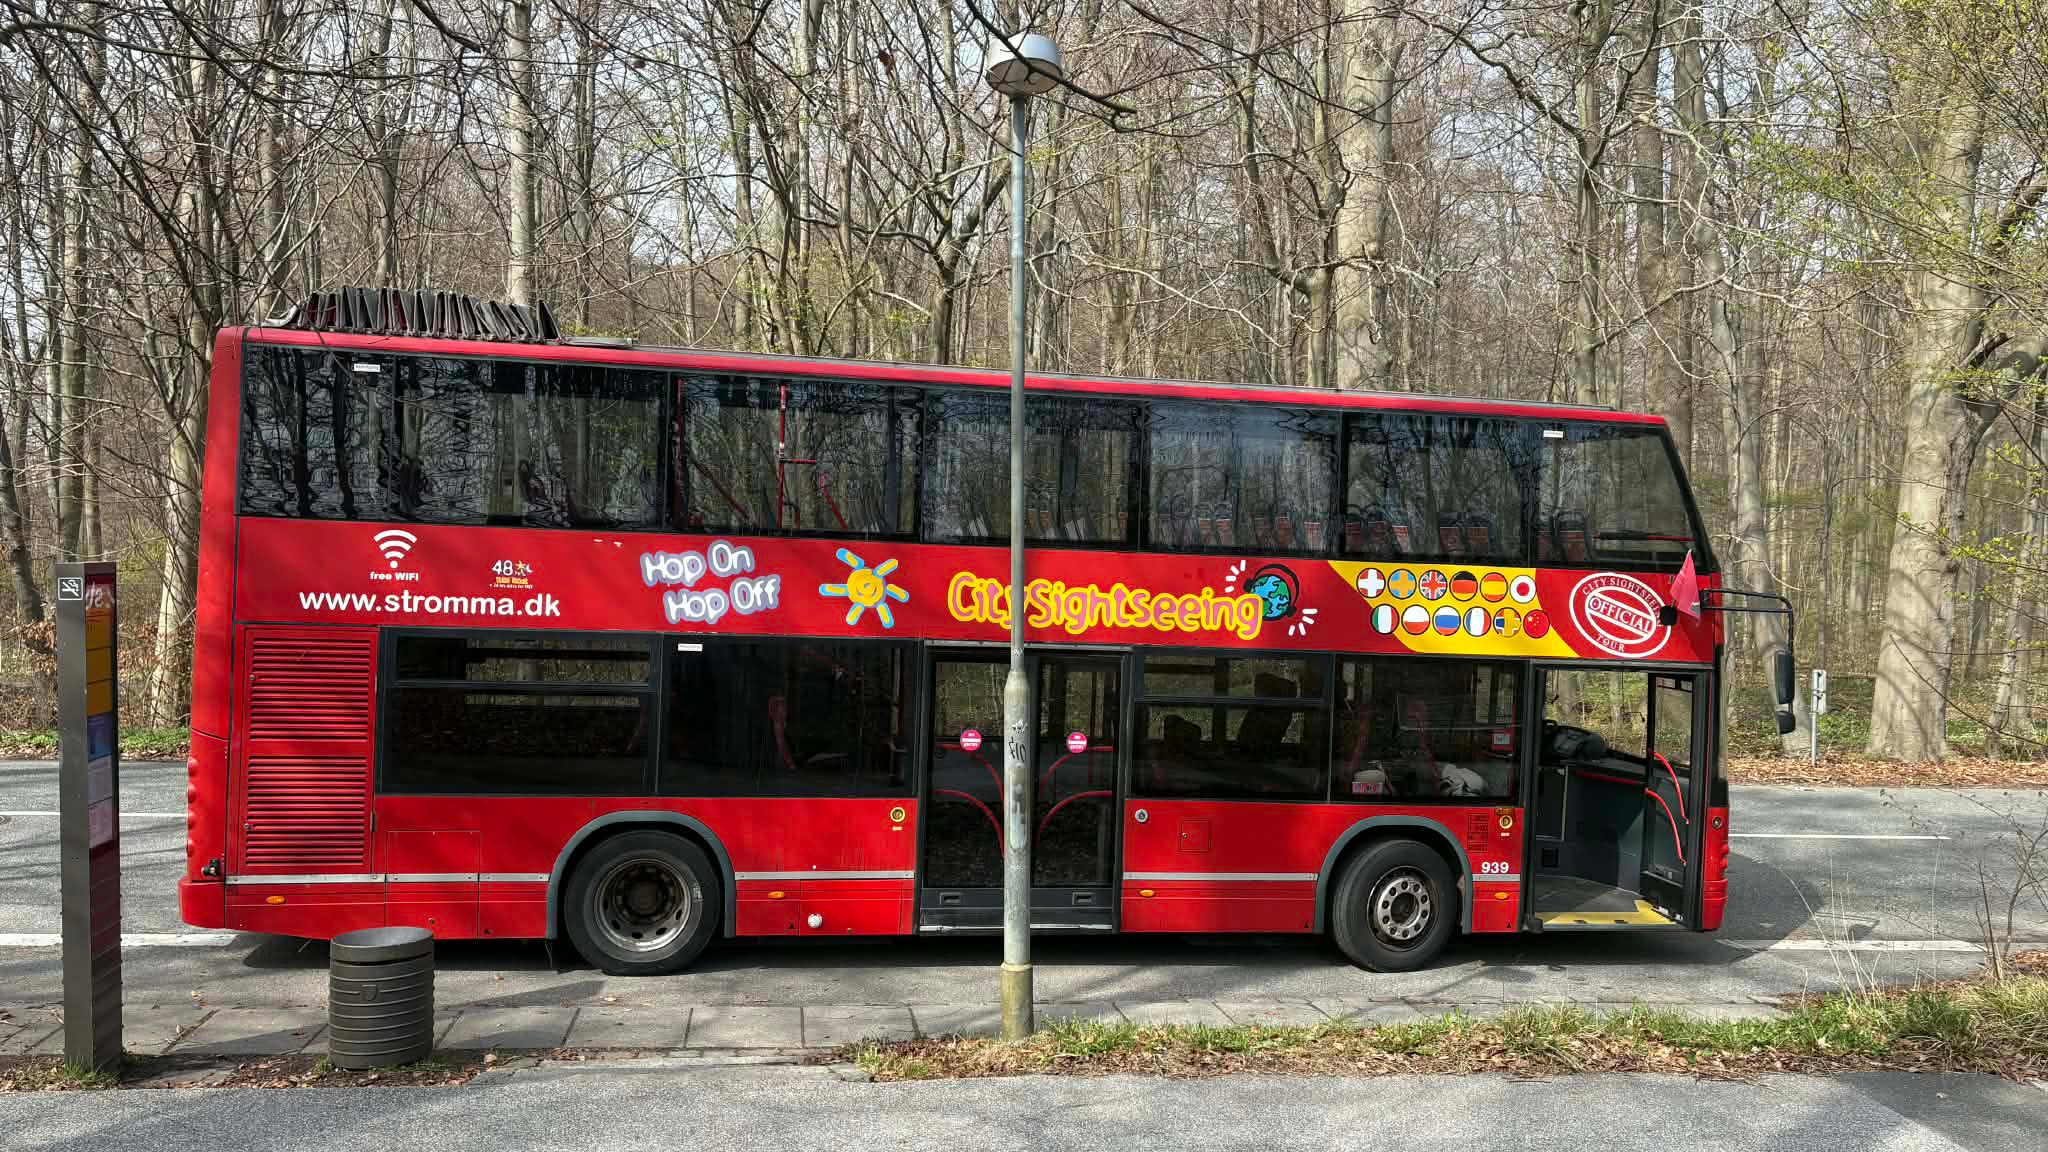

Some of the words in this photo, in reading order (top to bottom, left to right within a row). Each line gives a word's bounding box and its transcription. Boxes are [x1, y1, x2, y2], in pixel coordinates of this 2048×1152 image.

[492, 560, 513, 576] 48
[641, 552, 706, 586] Hop
[709, 541, 754, 576] On
[370, 571, 392, 580] free
[1582, 577, 1607, 596] CITY
[299, 590, 560, 617] www.stromma.dk
[664, 589, 728, 623] Hop
[731, 575, 780, 613] Off
[1589, 597, 1652, 633] OFFICIAL
[1597, 635, 1625, 652] TOUR
[1481, 861, 1510, 874] 939
